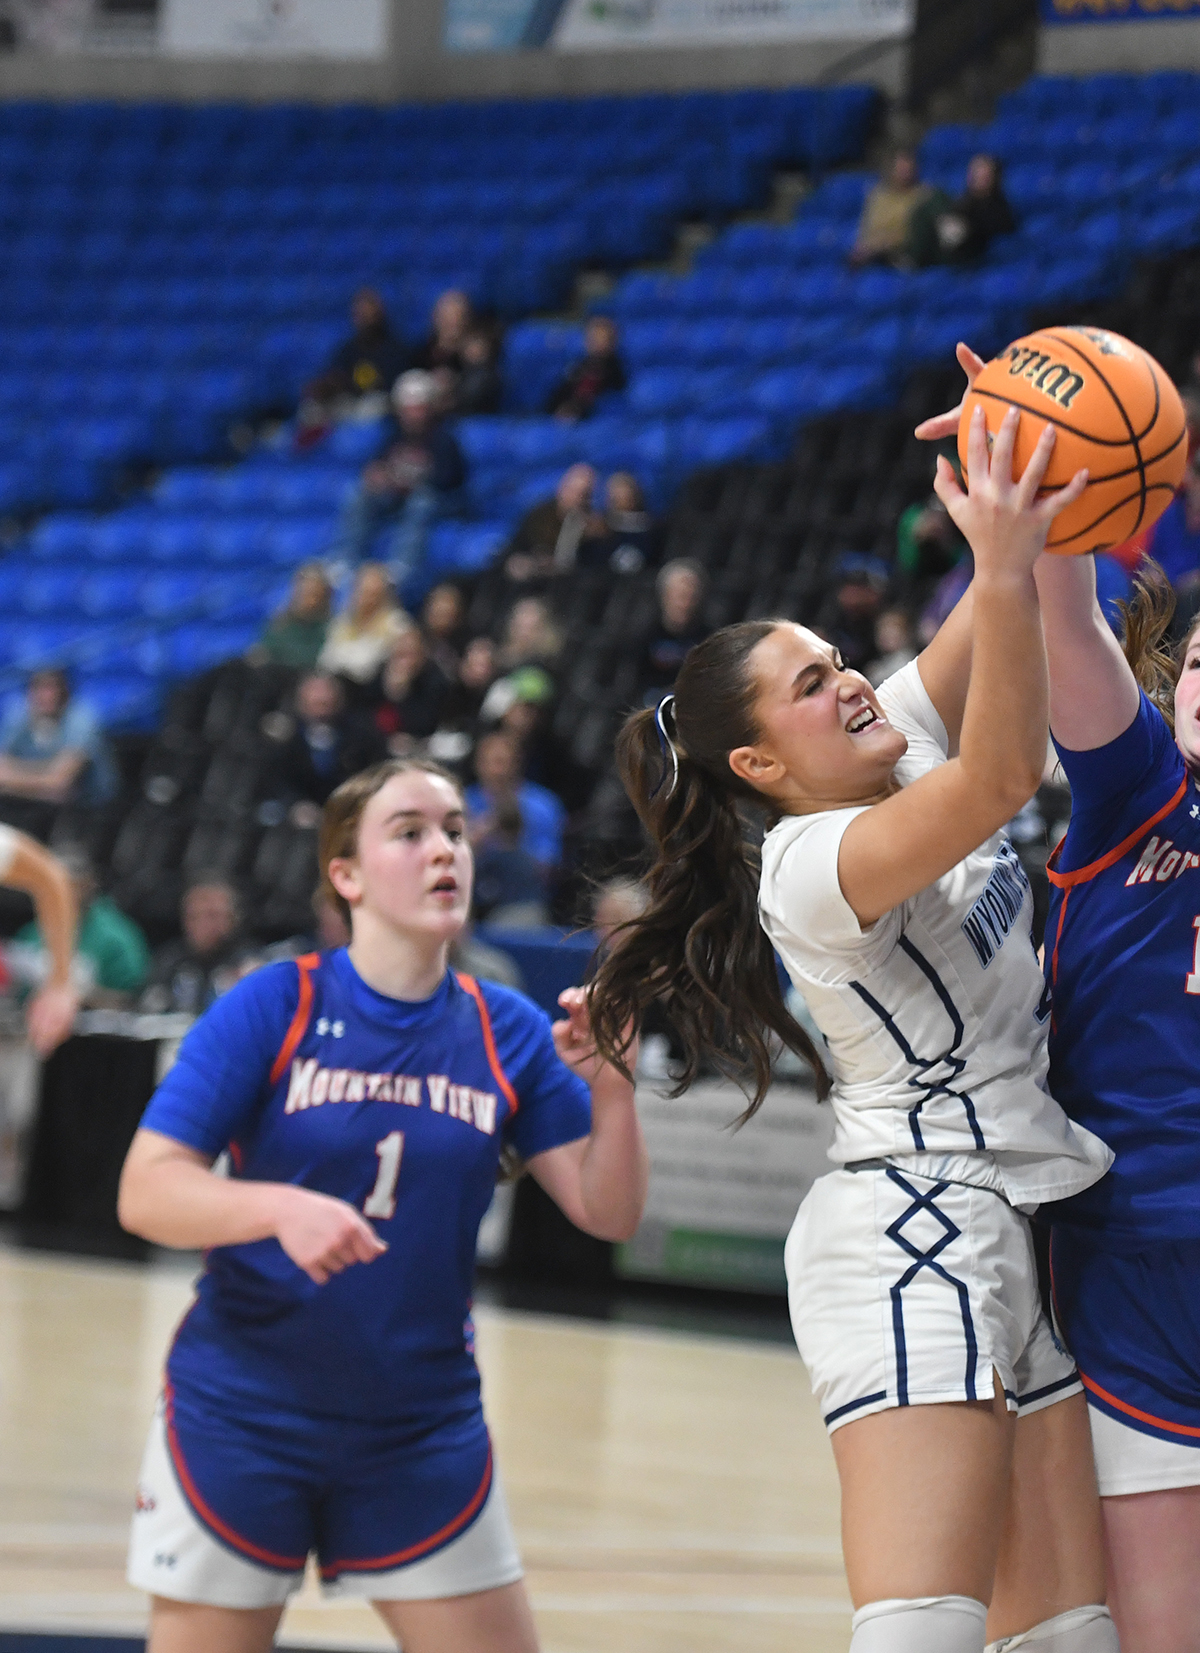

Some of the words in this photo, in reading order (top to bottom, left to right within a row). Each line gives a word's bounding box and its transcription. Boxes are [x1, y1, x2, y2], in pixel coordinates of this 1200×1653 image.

[284, 1057, 422, 1115] MOUNTAIN
[427, 1073, 497, 1136] VIEW
[363, 1130, 405, 1220] 1
